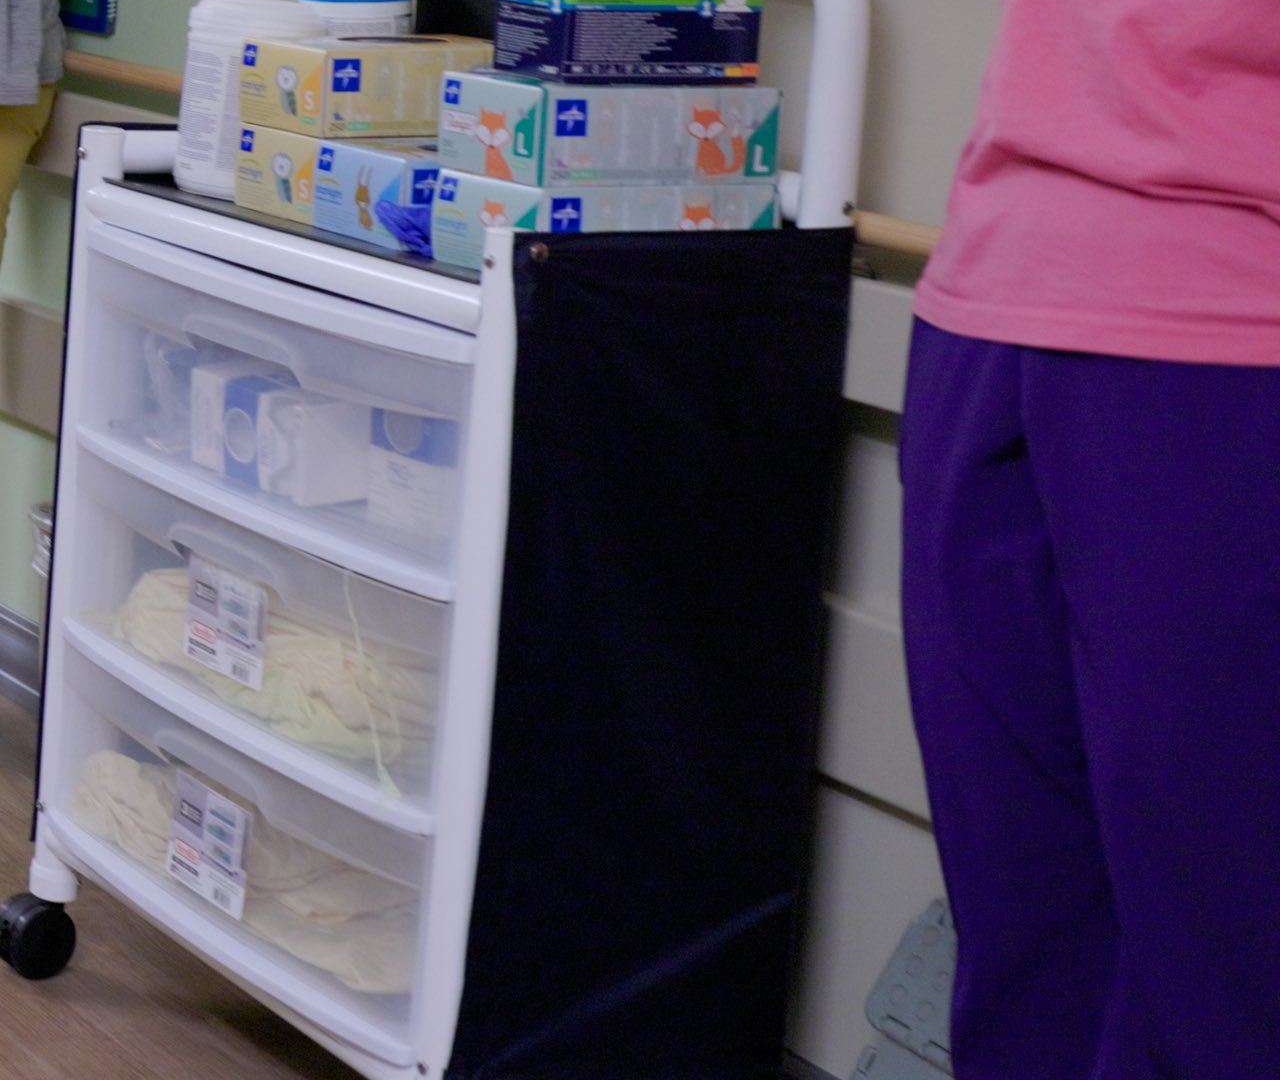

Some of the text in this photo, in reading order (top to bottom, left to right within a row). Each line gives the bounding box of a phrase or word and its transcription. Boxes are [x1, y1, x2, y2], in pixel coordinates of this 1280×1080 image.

[303, 91, 315, 110] S
[516, 132, 529, 155] L
[753, 145, 770, 173] L
[298, 178, 309, 198] S
